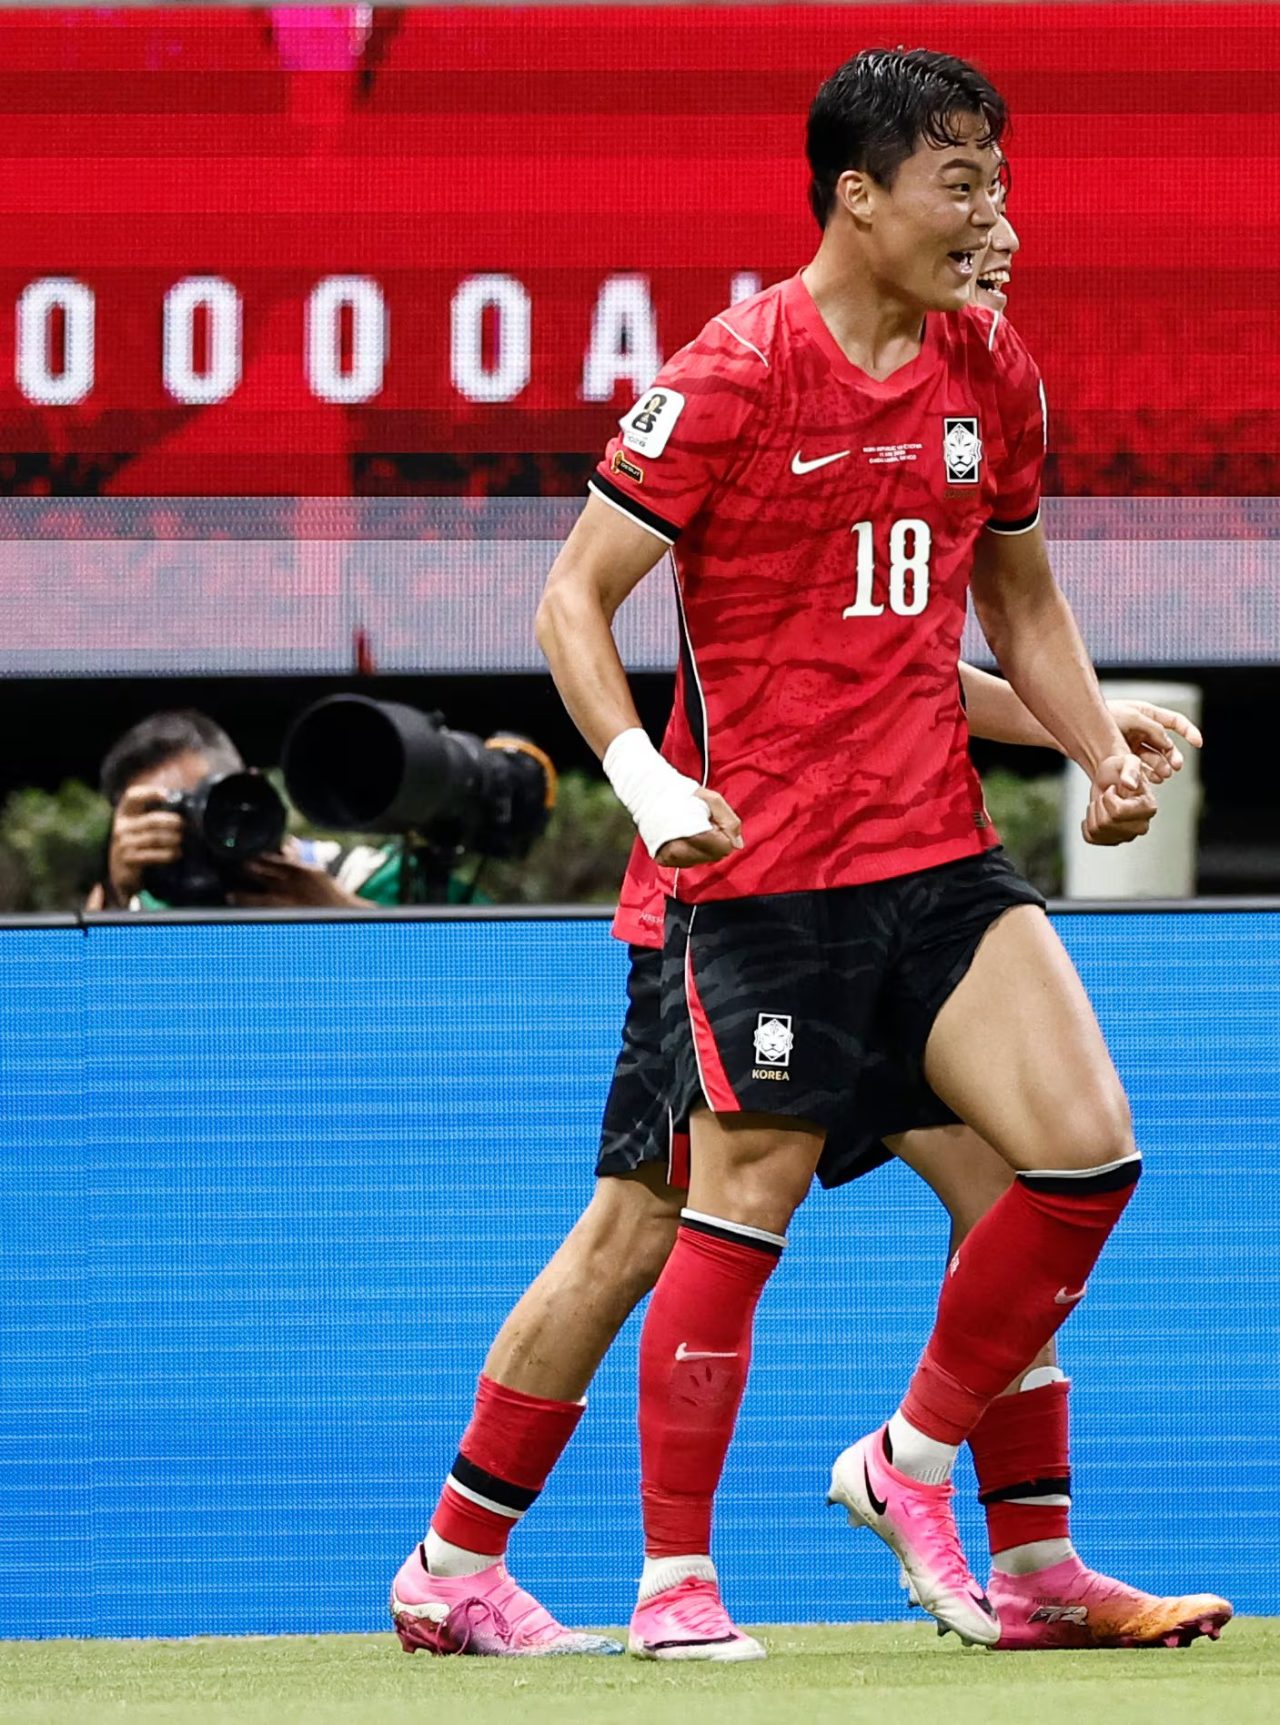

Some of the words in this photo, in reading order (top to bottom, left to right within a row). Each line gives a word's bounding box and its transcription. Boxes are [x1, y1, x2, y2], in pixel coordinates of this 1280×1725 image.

[15, 272, 762, 406] OOOOA
[842, 518, 932, 620] 18
[752, 1068, 790, 1081] KOREA
